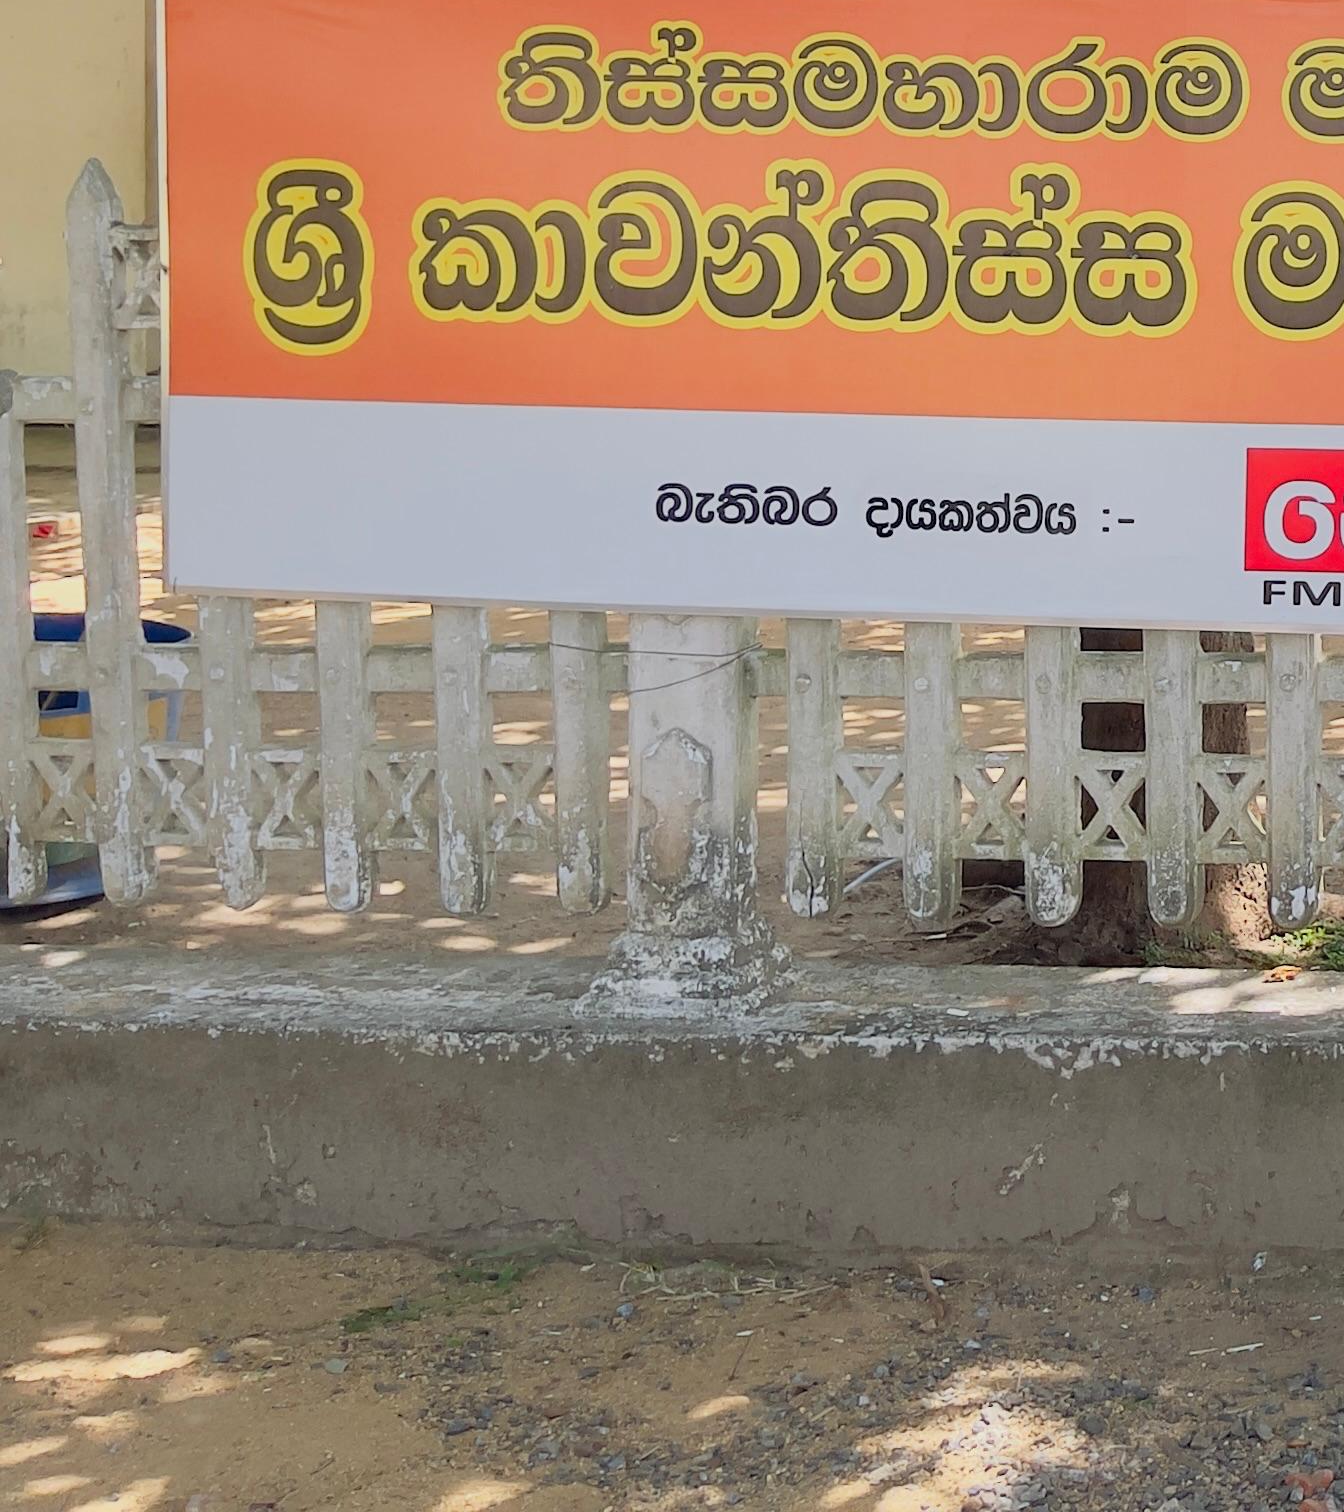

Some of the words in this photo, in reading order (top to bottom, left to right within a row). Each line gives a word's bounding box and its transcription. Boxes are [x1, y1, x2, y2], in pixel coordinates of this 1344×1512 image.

[499, 20, 1249, 141] තිස්සමහාරාම
[408, 159, 1198, 338] කාවන්තිස්ස
[655, 482, 839, 527] බැතිබර
[865, 491, 1078, 539] දායකත්වය
[1262, 580, 1342, 607] FM
